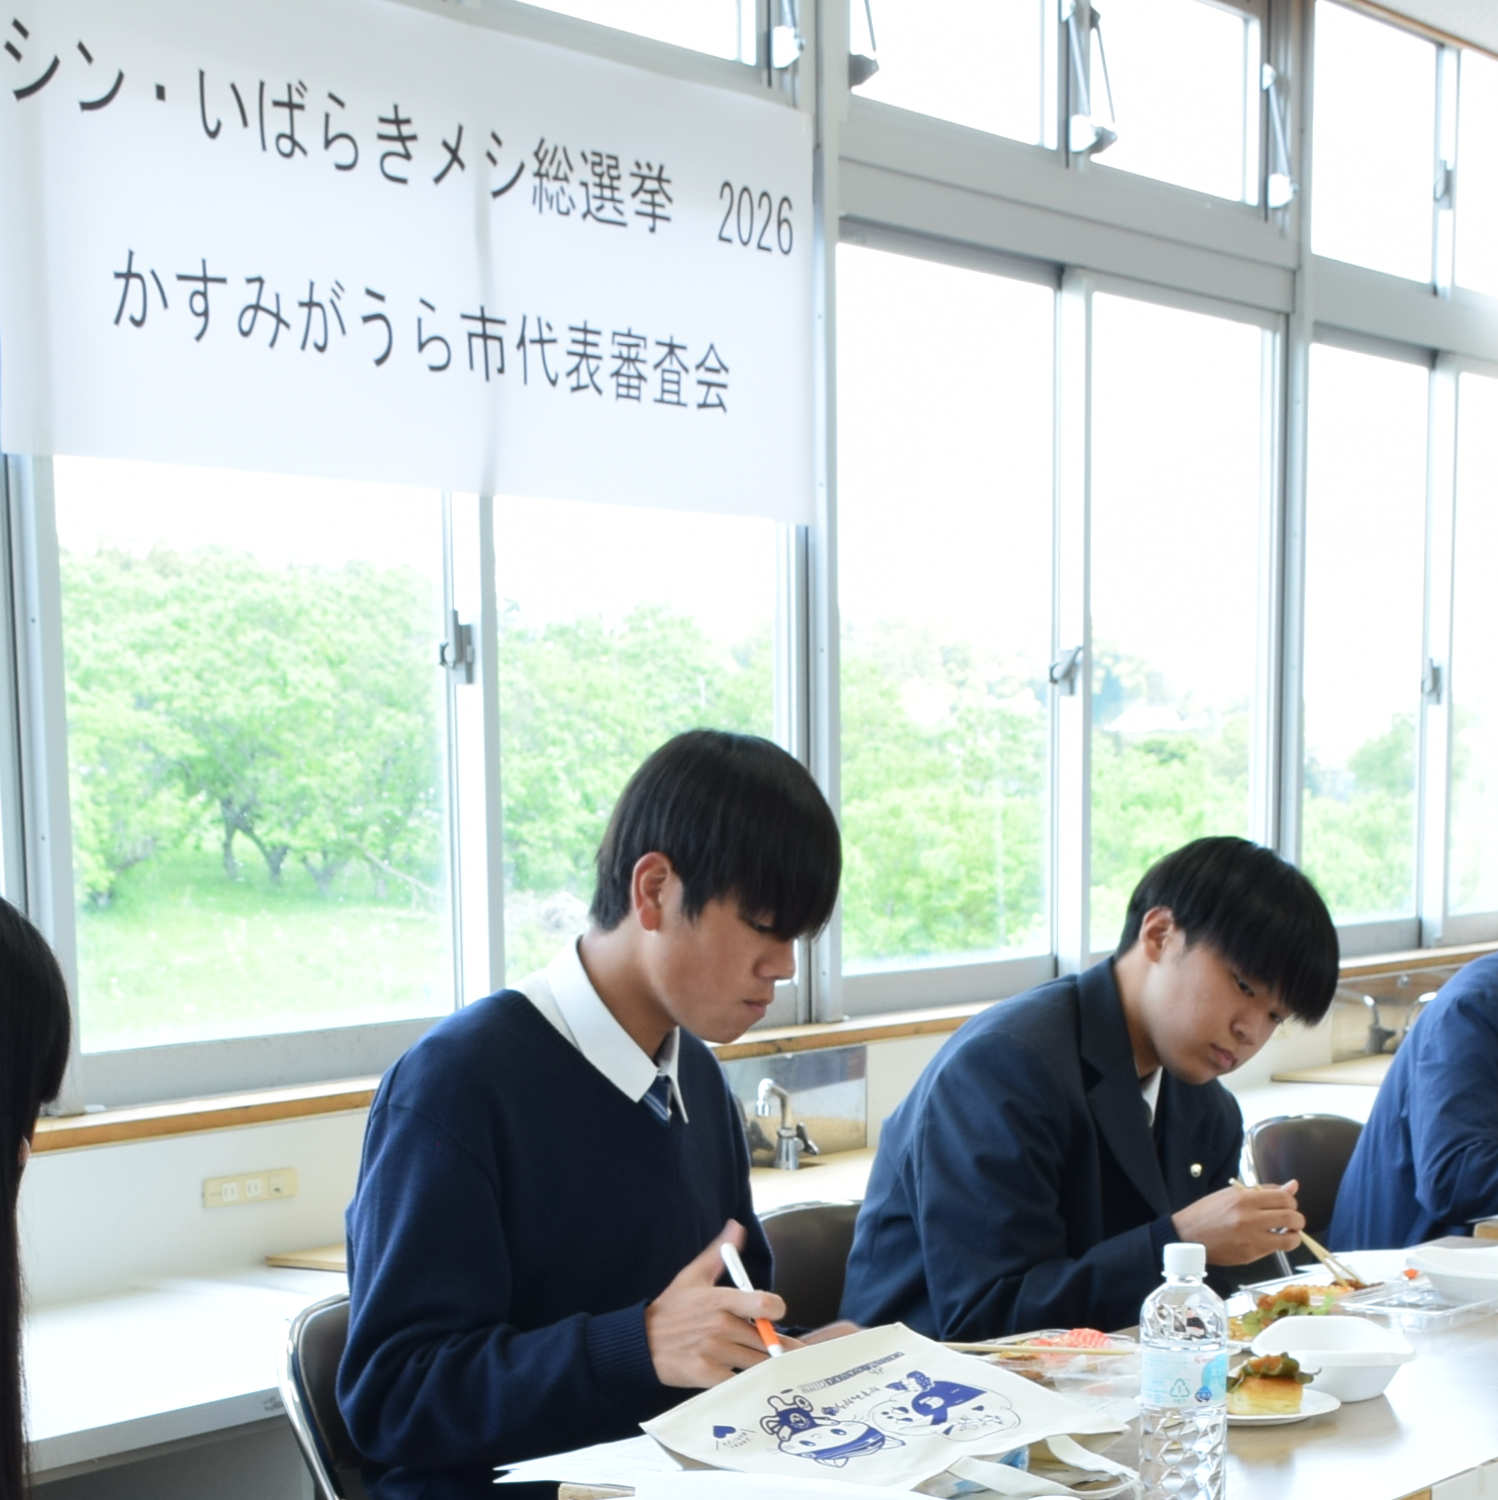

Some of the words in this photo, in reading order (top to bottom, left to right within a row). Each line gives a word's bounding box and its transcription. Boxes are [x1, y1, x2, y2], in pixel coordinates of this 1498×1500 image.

[3, 17, 674, 234] シン・いばらきメシ総選挙
[717, 180, 794, 257] 2026
[112, 248, 731, 414] かすみがうら市代表審査会
